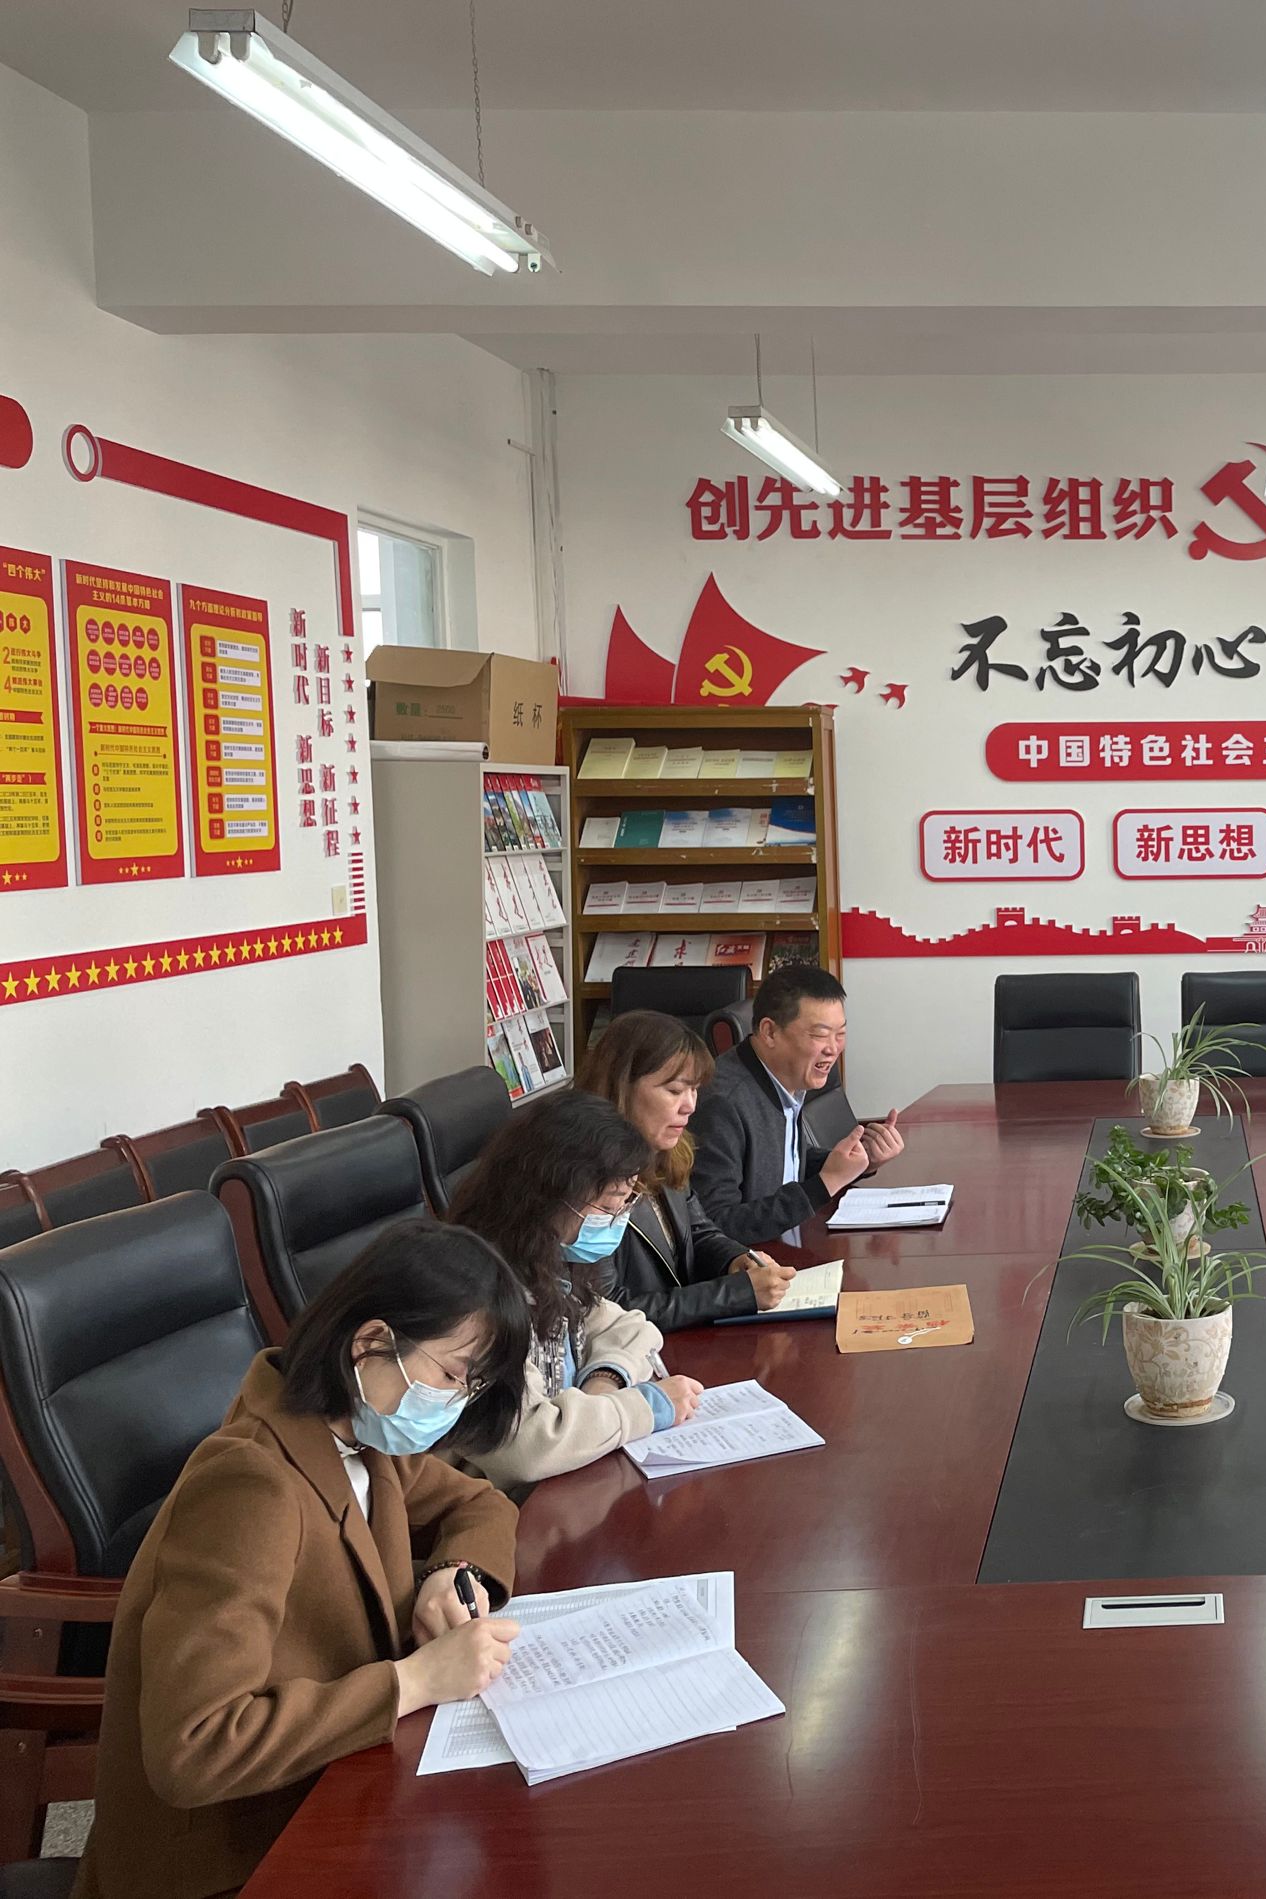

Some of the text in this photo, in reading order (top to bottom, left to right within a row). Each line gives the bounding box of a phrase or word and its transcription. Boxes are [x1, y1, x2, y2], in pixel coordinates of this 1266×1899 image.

[686, 475, 1178, 541] 创先进基层组织
[950, 611, 1266, 692] 不忘初心
[292, 609, 316, 828] 新时代 新思想
[512, 701, 543, 729] 纸杯
[316, 644, 339, 858] 新目标 新征程
[943, 826, 1066, 865] 新时代
[1135, 823, 1257, 863] 新思想
